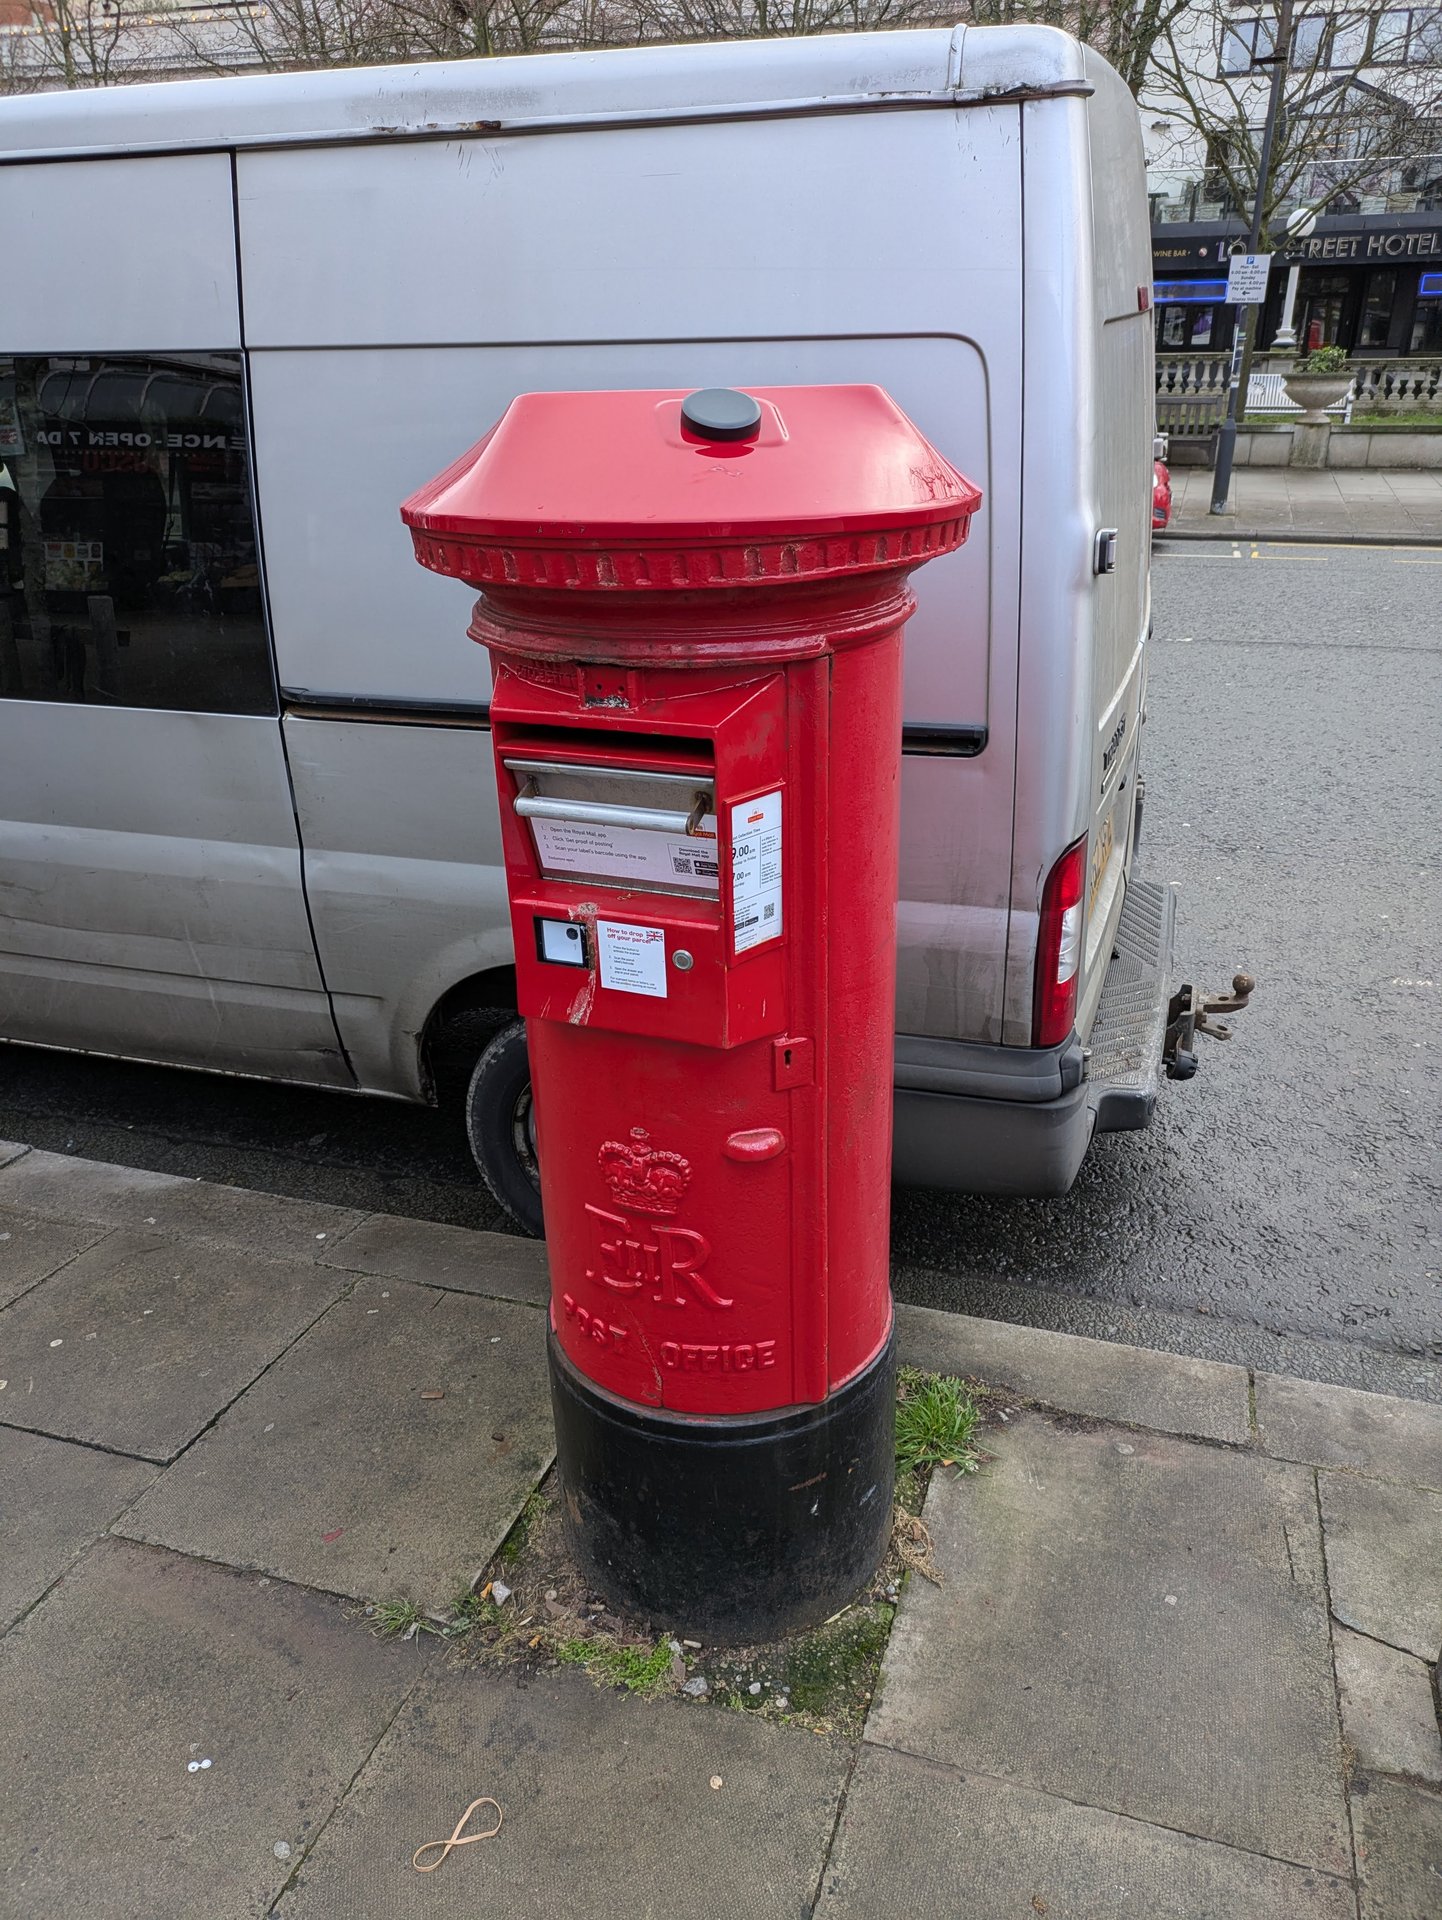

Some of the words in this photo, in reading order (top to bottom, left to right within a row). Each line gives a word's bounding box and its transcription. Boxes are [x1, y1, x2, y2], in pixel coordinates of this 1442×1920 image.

[1367, 232, 1442, 257] HOTEL
[1173, 249, 1186, 257] BAR
[629, 930, 643, 938] drop
[660, 1339, 776, 1373] OFFICE
